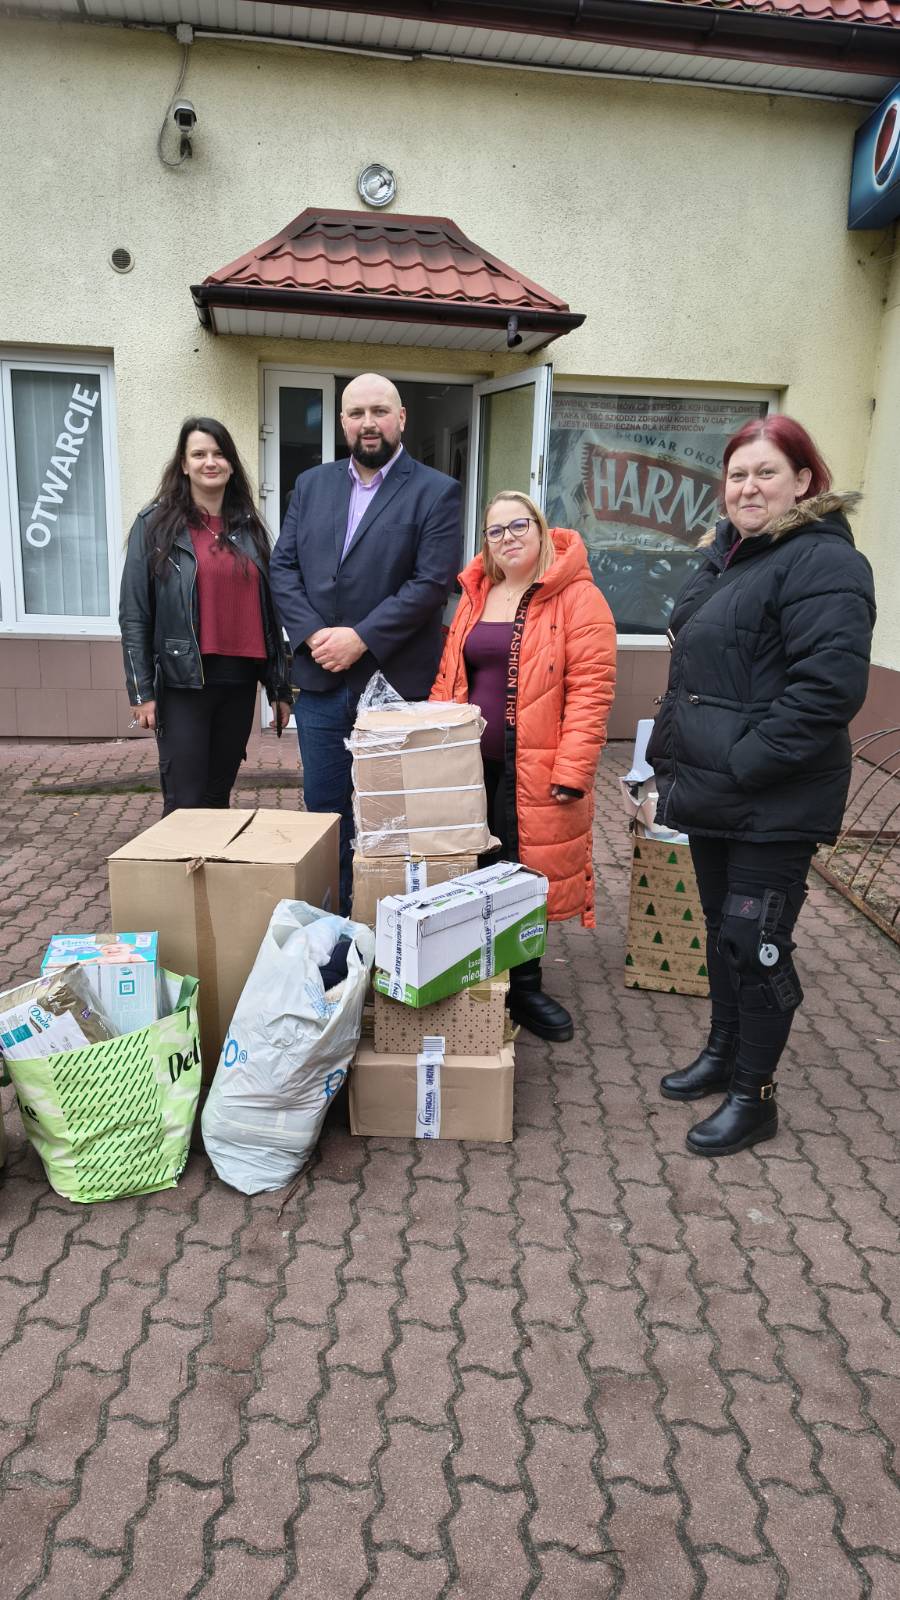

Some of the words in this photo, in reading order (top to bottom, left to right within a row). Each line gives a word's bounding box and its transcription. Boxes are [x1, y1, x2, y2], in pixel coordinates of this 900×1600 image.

[26, 383, 99, 548] OTWARCIE
[507, 622, 525, 688] FASHION
[505, 694, 516, 726] TRIP
